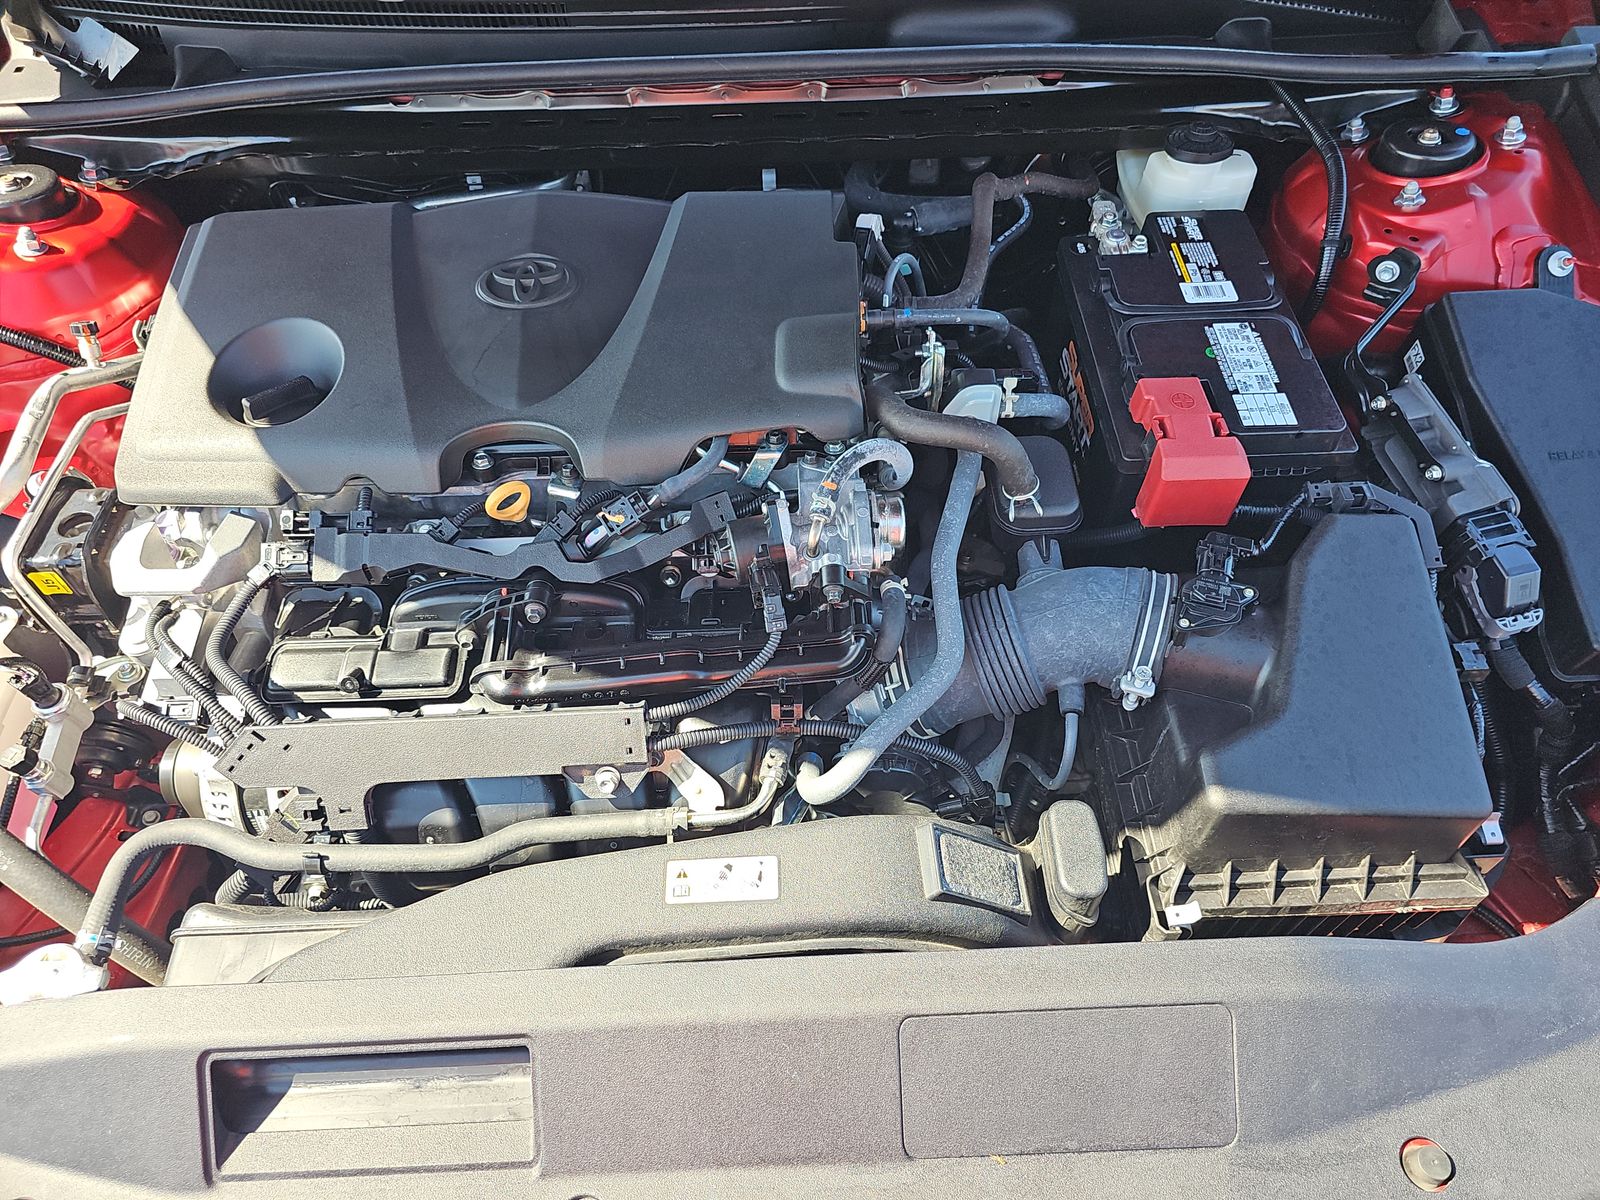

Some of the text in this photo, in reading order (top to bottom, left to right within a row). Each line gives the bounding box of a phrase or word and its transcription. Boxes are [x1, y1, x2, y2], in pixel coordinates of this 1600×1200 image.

[1060, 347, 1090, 447] START
[1068, 340, 1095, 440] SUPER
[1547, 449, 1585, 461] RELAY
